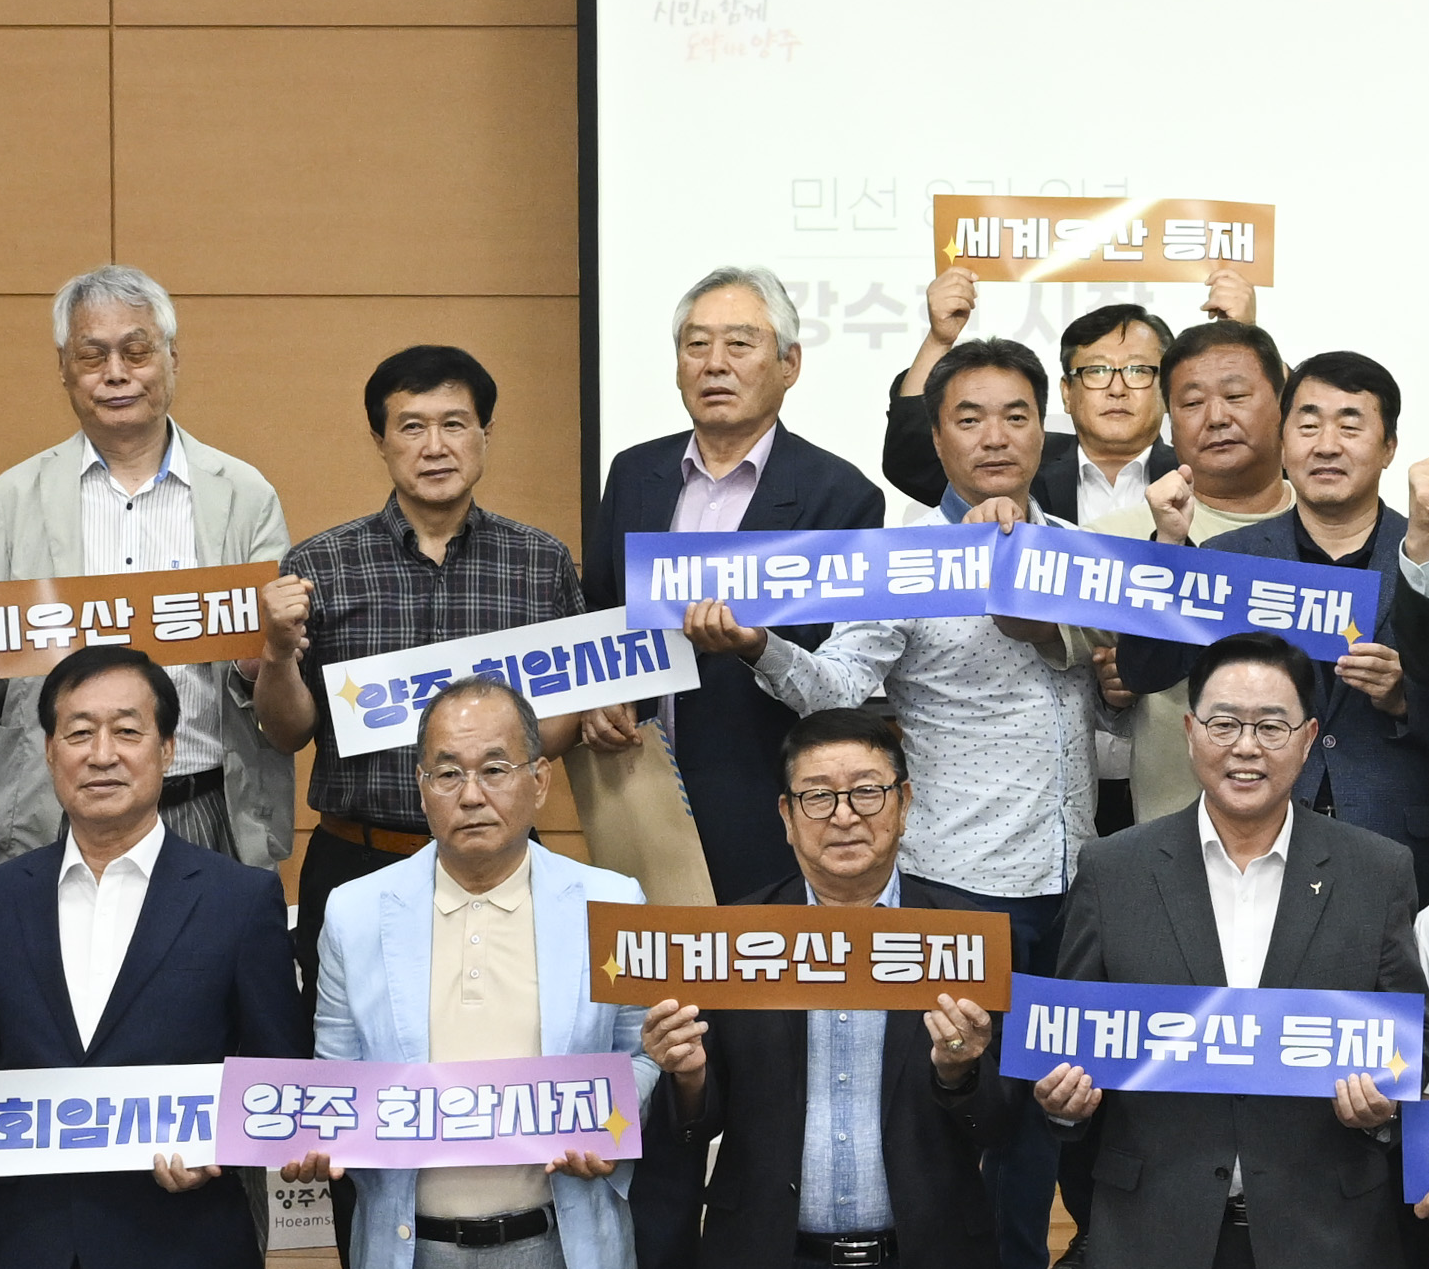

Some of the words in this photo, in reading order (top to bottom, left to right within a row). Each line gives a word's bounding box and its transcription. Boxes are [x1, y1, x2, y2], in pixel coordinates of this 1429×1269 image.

[750, 28, 804, 63] 양주
[791, 176, 899, 232] 민선
[955, 216, 1149, 262] 세계유산
[1162, 220, 1257, 265] 등재
[649, 553, 865, 604] 세계유산
[886, 544, 990, 595] 등재
[1013, 546, 1233, 622] 세계유산
[1245, 583, 1354, 636] 등재
[151, 585, 262, 645] 등재
[615, 929, 853, 983] 세계유산
[869, 932, 987, 983] 등재
[1024, 1002, 1261, 1066] 세계유산
[1279, 1014, 1396, 1071] 등재
[241, 1082, 358, 1141] 양주
[375, 1076, 612, 1140] 회암사지
